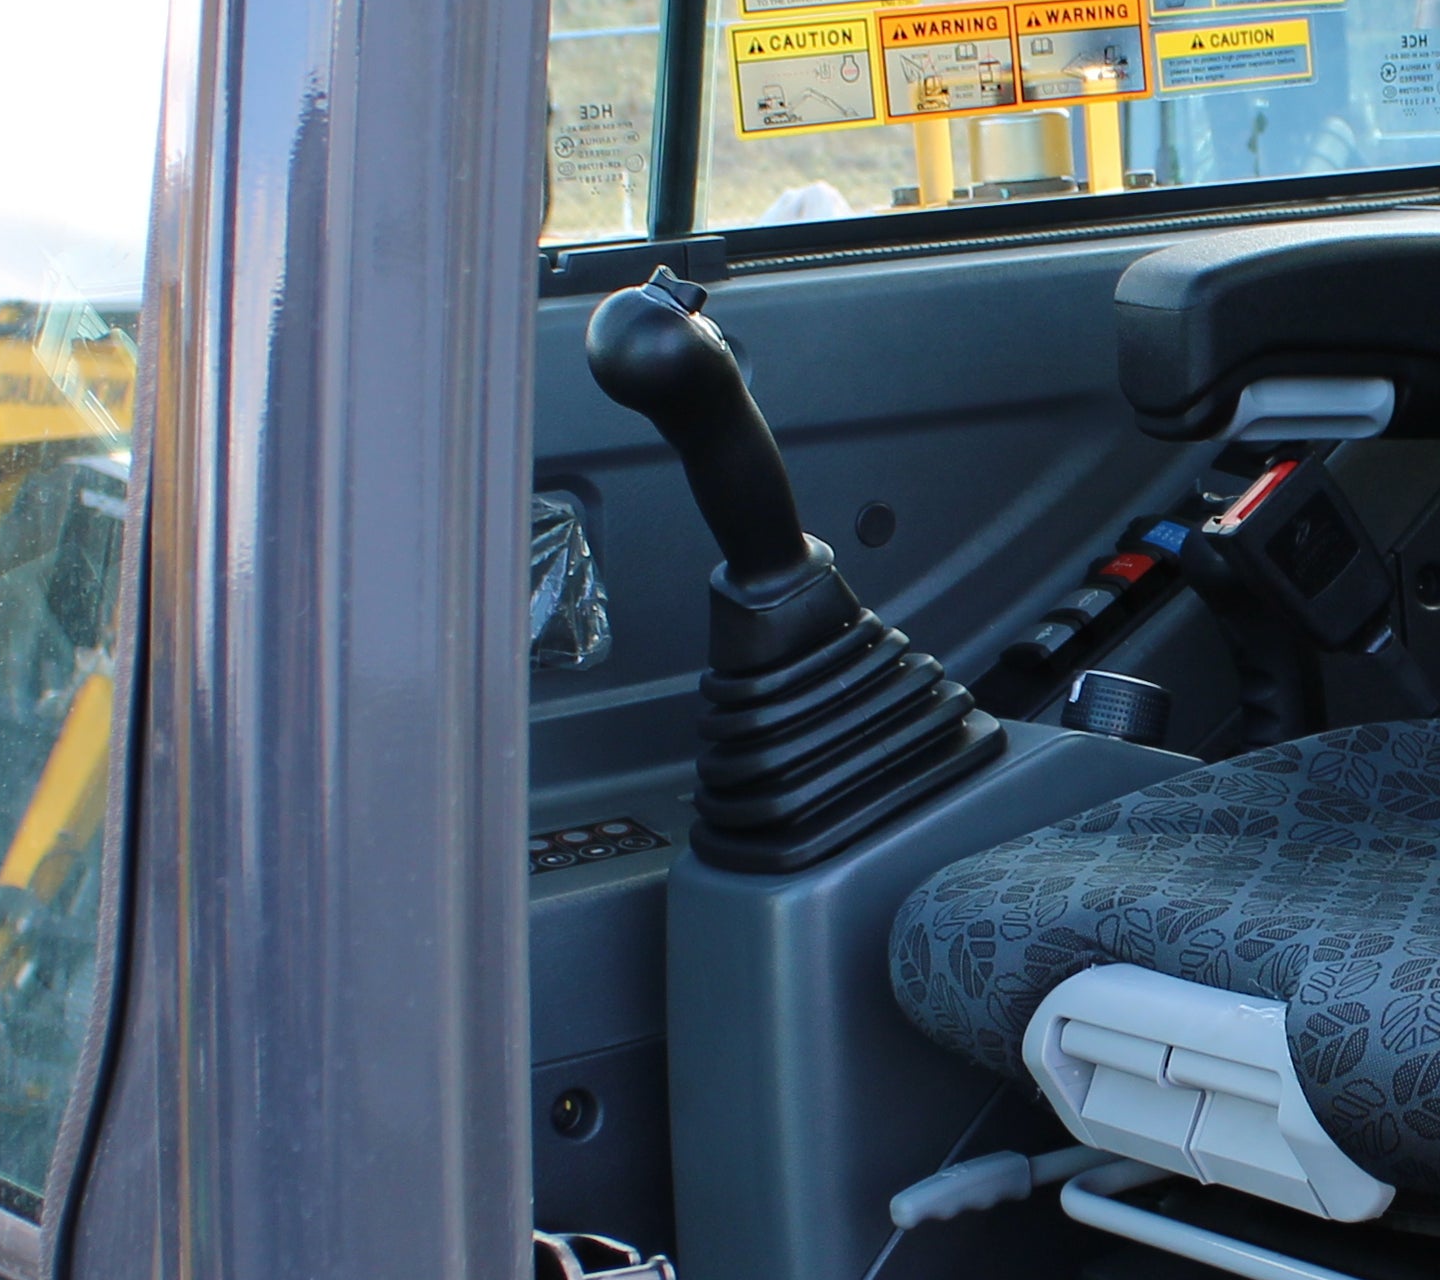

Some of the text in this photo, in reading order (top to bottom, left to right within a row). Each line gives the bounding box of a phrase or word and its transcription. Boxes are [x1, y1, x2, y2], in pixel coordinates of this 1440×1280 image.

[1045, 3, 1129, 25] WARNING
[912, 16, 998, 38] WARNING
[1210, 28, 1275, 48] CAUTION
[769, 28, 854, 51] CAUTION
